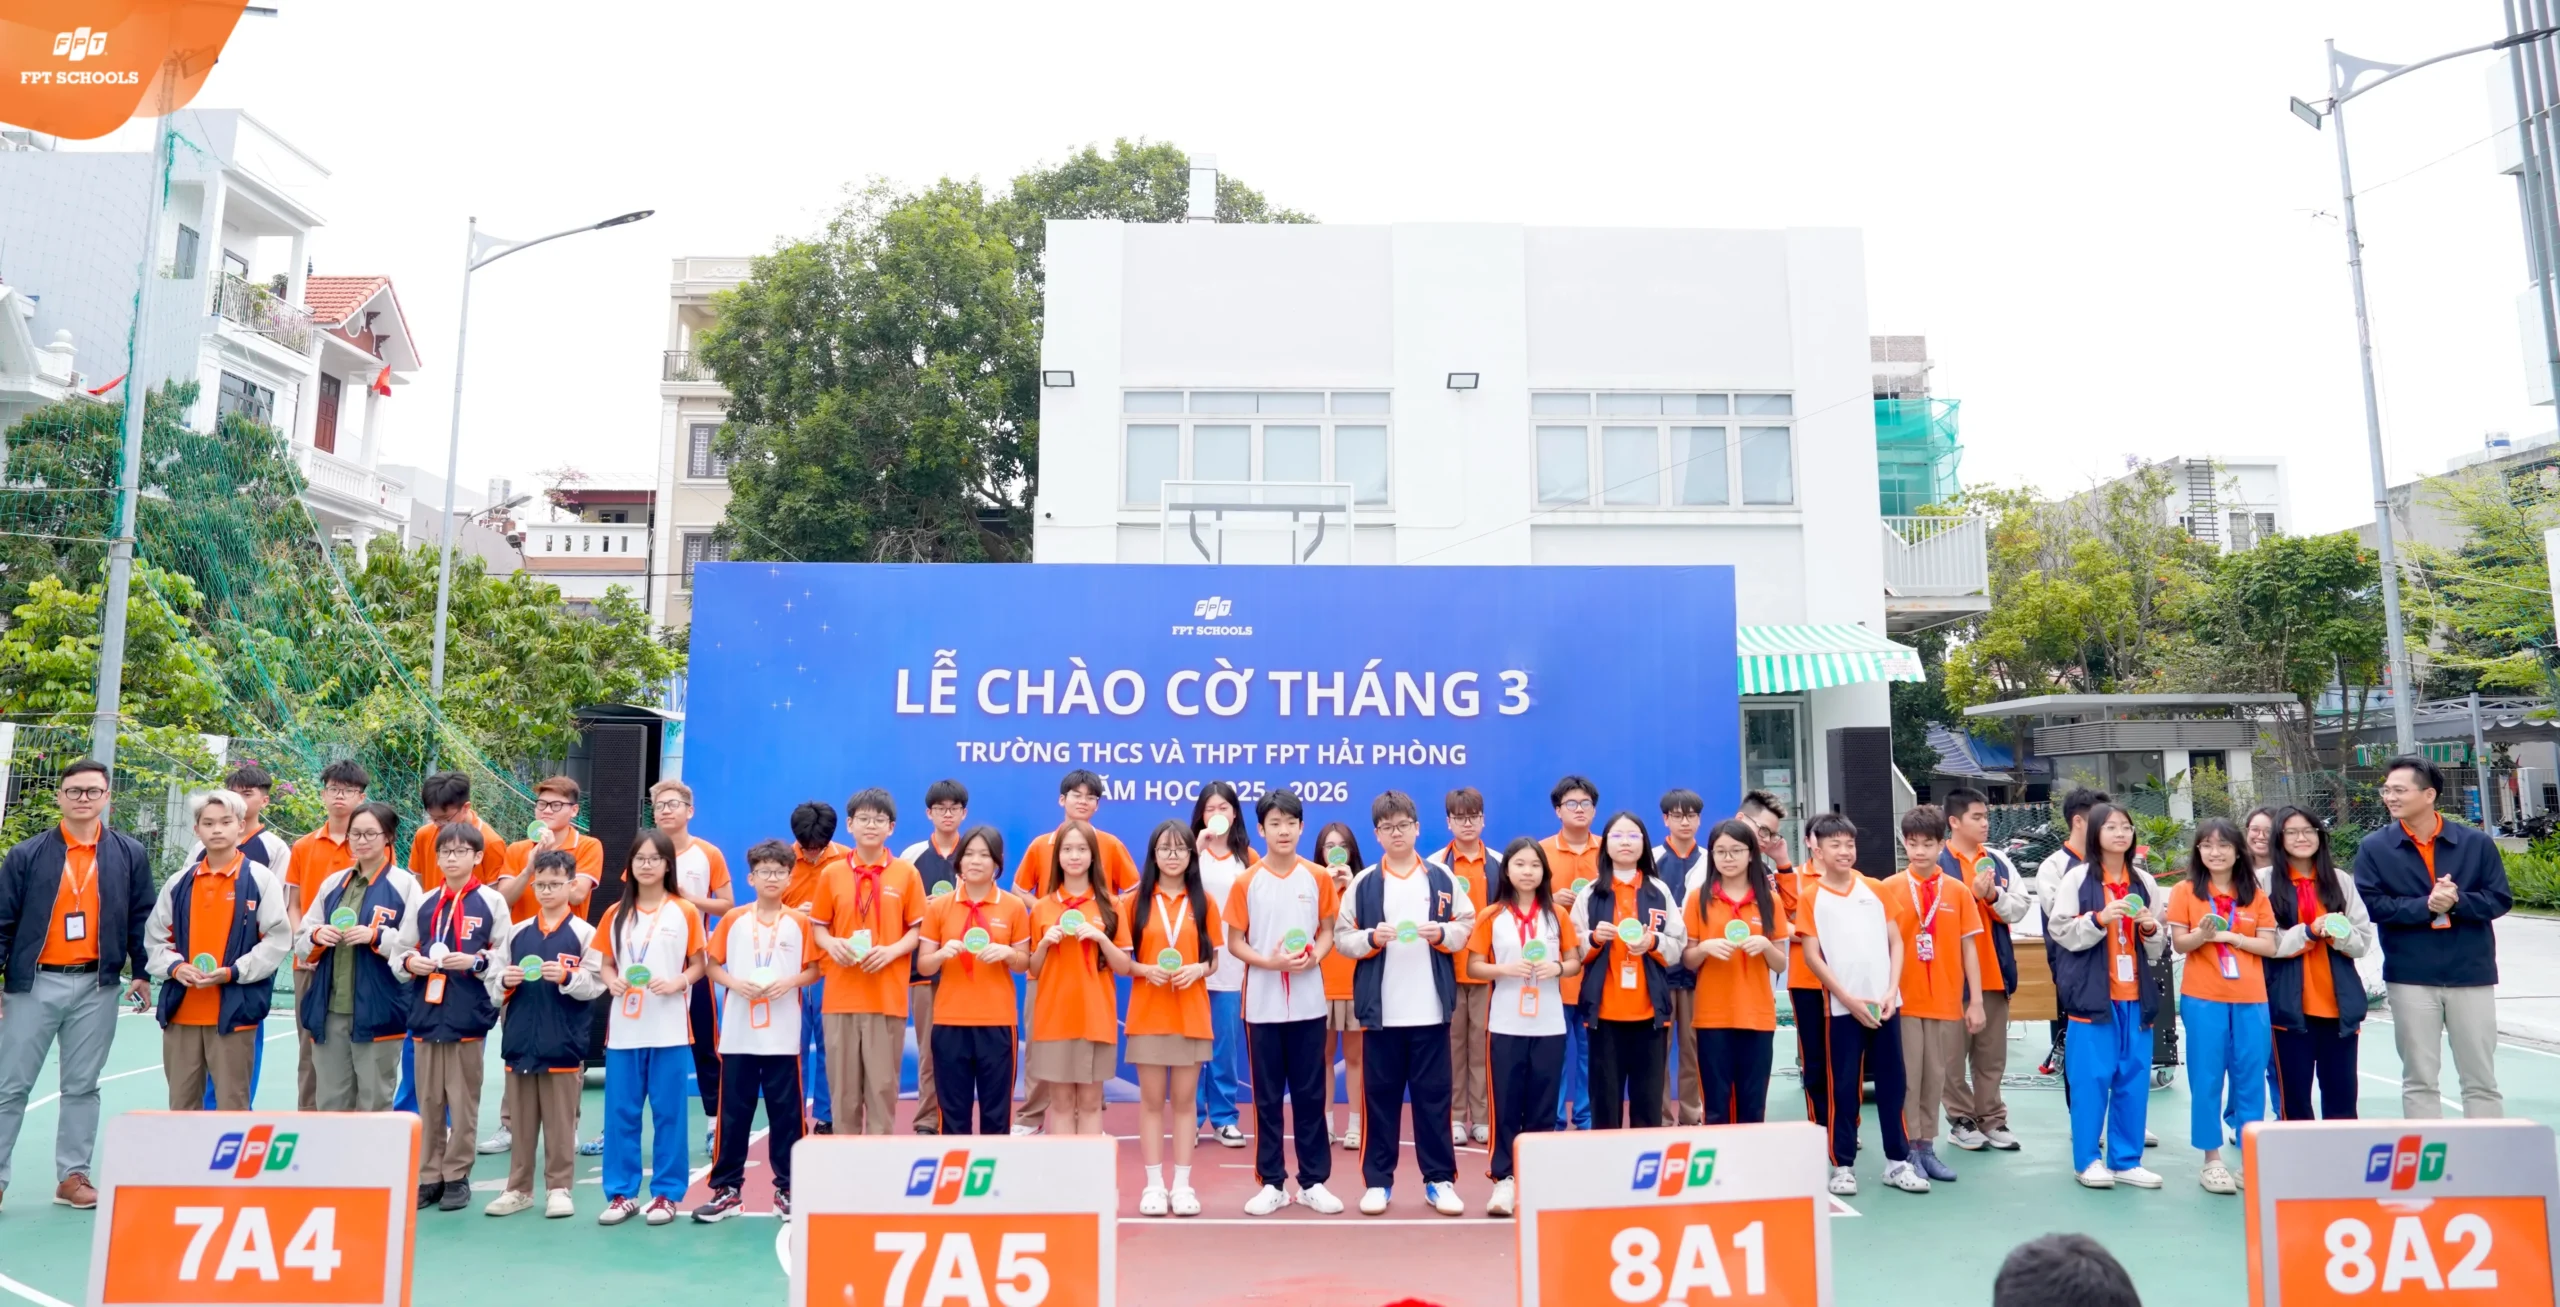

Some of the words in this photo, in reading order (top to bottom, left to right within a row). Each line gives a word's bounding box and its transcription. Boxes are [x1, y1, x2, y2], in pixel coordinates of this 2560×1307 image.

[1194, 598, 1231, 618] FPT
[1172, 626, 1194, 635] FPT
[1196, 626, 1253, 636] SCHOOLS
[896, 649, 957, 714] LỄ
[977, 657, 1146, 716] CHÀO
[1166, 658, 1255, 717] CỜ
[1268, 658, 1480, 718] THÁNG
[1498, 670, 1530, 716] 3
[956, 737, 1070, 763] TRƯỜNG
[1078, 743, 1143, 763] THCS
[1150, 738, 1185, 764] VÀ
[1192, 744, 1257, 765] THPT
[1265, 744, 1310, 764] FPT
[1317, 737, 1364, 765] HẢI
[1372, 739, 1466, 765] PHÒNG
[1099, 774, 1136, 801] ĂM
[1145, 780, 1200, 807] HỌC
[1226, 781, 1266, 802] 25
[1289, 781, 1349, 803] 2026
[368, 905, 397, 928] F
[460, 916, 483, 940] F
[1648, 908, 1667, 932] F
[210, 1131, 298, 1172] FPT
[1632, 1148, 1716, 1189] FPT
[2365, 1141, 2447, 1183] FPT
[906, 1156, 996, 1197] FPT
[174, 1207, 342, 1281] 7A4
[1610, 1220, 1766, 1303] 8A1
[2324, 1213, 2498, 1295] 8A2
[874, 1232, 1050, 1307] 7A5
